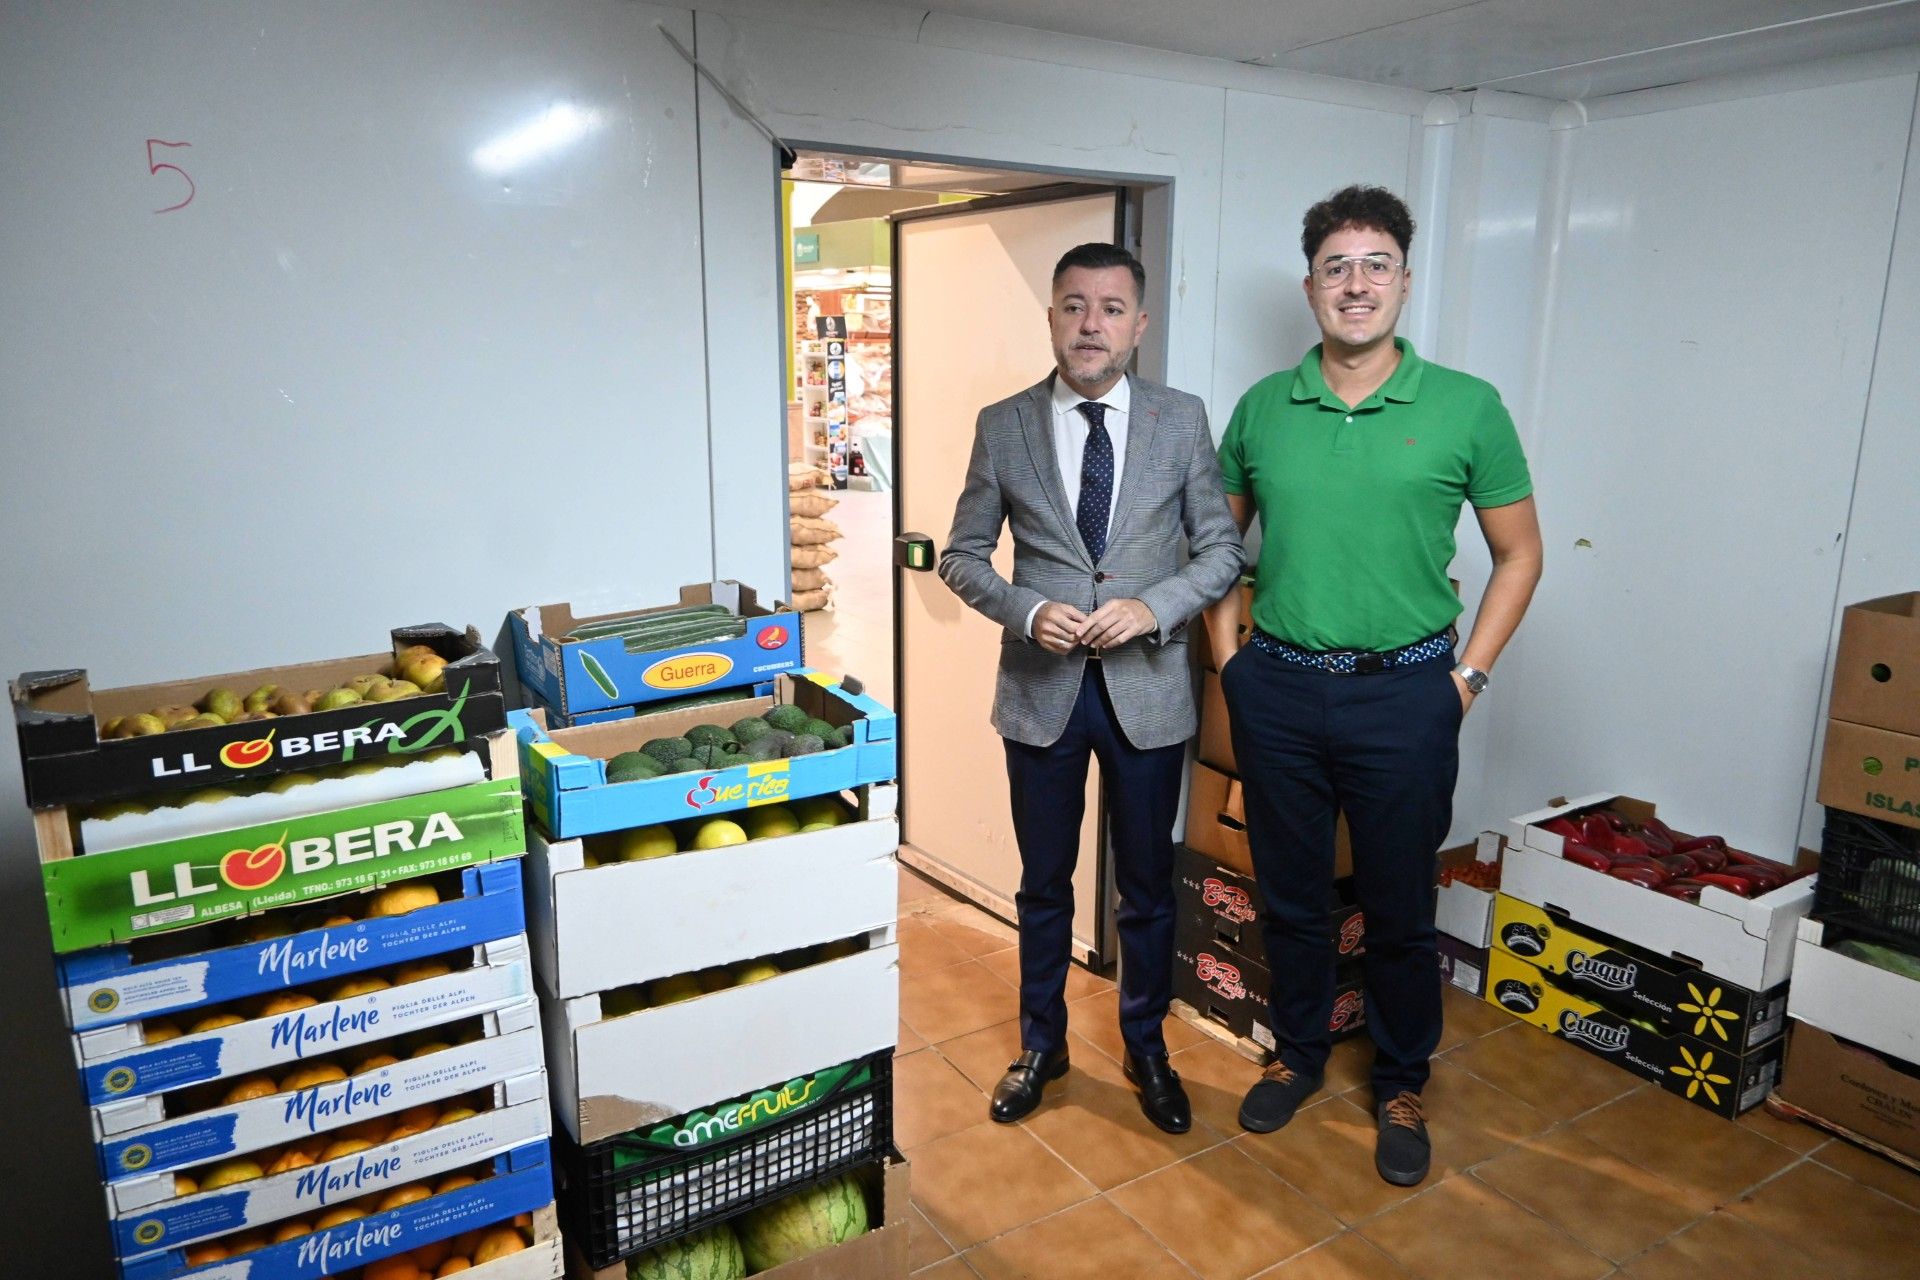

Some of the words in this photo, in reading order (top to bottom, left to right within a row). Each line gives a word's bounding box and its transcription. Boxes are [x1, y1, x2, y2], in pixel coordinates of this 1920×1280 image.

[146, 139, 195, 214] 5
[660, 663, 717, 682] Guerra
[1905, 757, 1920, 773] P
[201, 901, 243, 917] ALBESA
[336, 877, 352, 889] 973
[355, 875, 366, 885] 18
[381, 868, 392, 879] 31
[399, 864, 418, 875] FAX:
[420, 859, 435, 870] 973
[437, 856, 448, 866] 18
[449, 854, 459, 864] 61
[382, 930, 409, 940] FIGLIA
[410, 924, 435, 935] DELLE
[438, 919, 456, 928] ALPI
[382, 935, 420, 948] TOCHTER
[422, 931, 438, 940] DER
[441, 925, 466, 936] ALPEN
[258, 932, 369, 984] Marlene
[1565, 949, 1637, 988] Cuqui
[392, 1001, 419, 1011] FIGLIA
[421, 995, 445, 1005] DELLE
[448, 989, 466, 998] ALPI
[393, 1006, 430, 1019] TOCHTER
[433, 1001, 448, 1010] DER
[451, 996, 475, 1006] ALPEN
[1632, 990, 1673, 1013] Selección
[271, 1005, 380, 1058] Marlene
[1559, 1008, 1630, 1047] Cuqui
[404, 1073, 431, 1084] FIGLIA
[433, 1066, 457, 1076] DELLE
[459, 1060, 478, 1069] ALPI
[1625, 1051, 1665, 1075] Selección
[405, 1078, 441, 1091] TOCHTER
[444, 1073, 459, 1082] DER
[462, 1065, 487, 1076] ALPEN
[285, 1079, 392, 1132] Marlene
[413, 1146, 439, 1157] FIGLIA
[441, 1137, 465, 1148] DELLE
[467, 1132, 485, 1141] ALPI
[414, 1150, 449, 1165] TOCHTER
[452, 1144, 467, 1154] DER
[469, 1136, 494, 1147] ALPEN
[296, 1156, 401, 1205] Marlene
[413, 1212, 440, 1225] FIGLIA
[442, 1204, 466, 1215] DELLE
[468, 1198, 486, 1207] ALPI
[414, 1217, 450, 1231] TOCHTER
[452, 1211, 468, 1221] DER
[470, 1203, 495, 1214] ALPEN
[297, 1221, 402, 1275] Marlene
